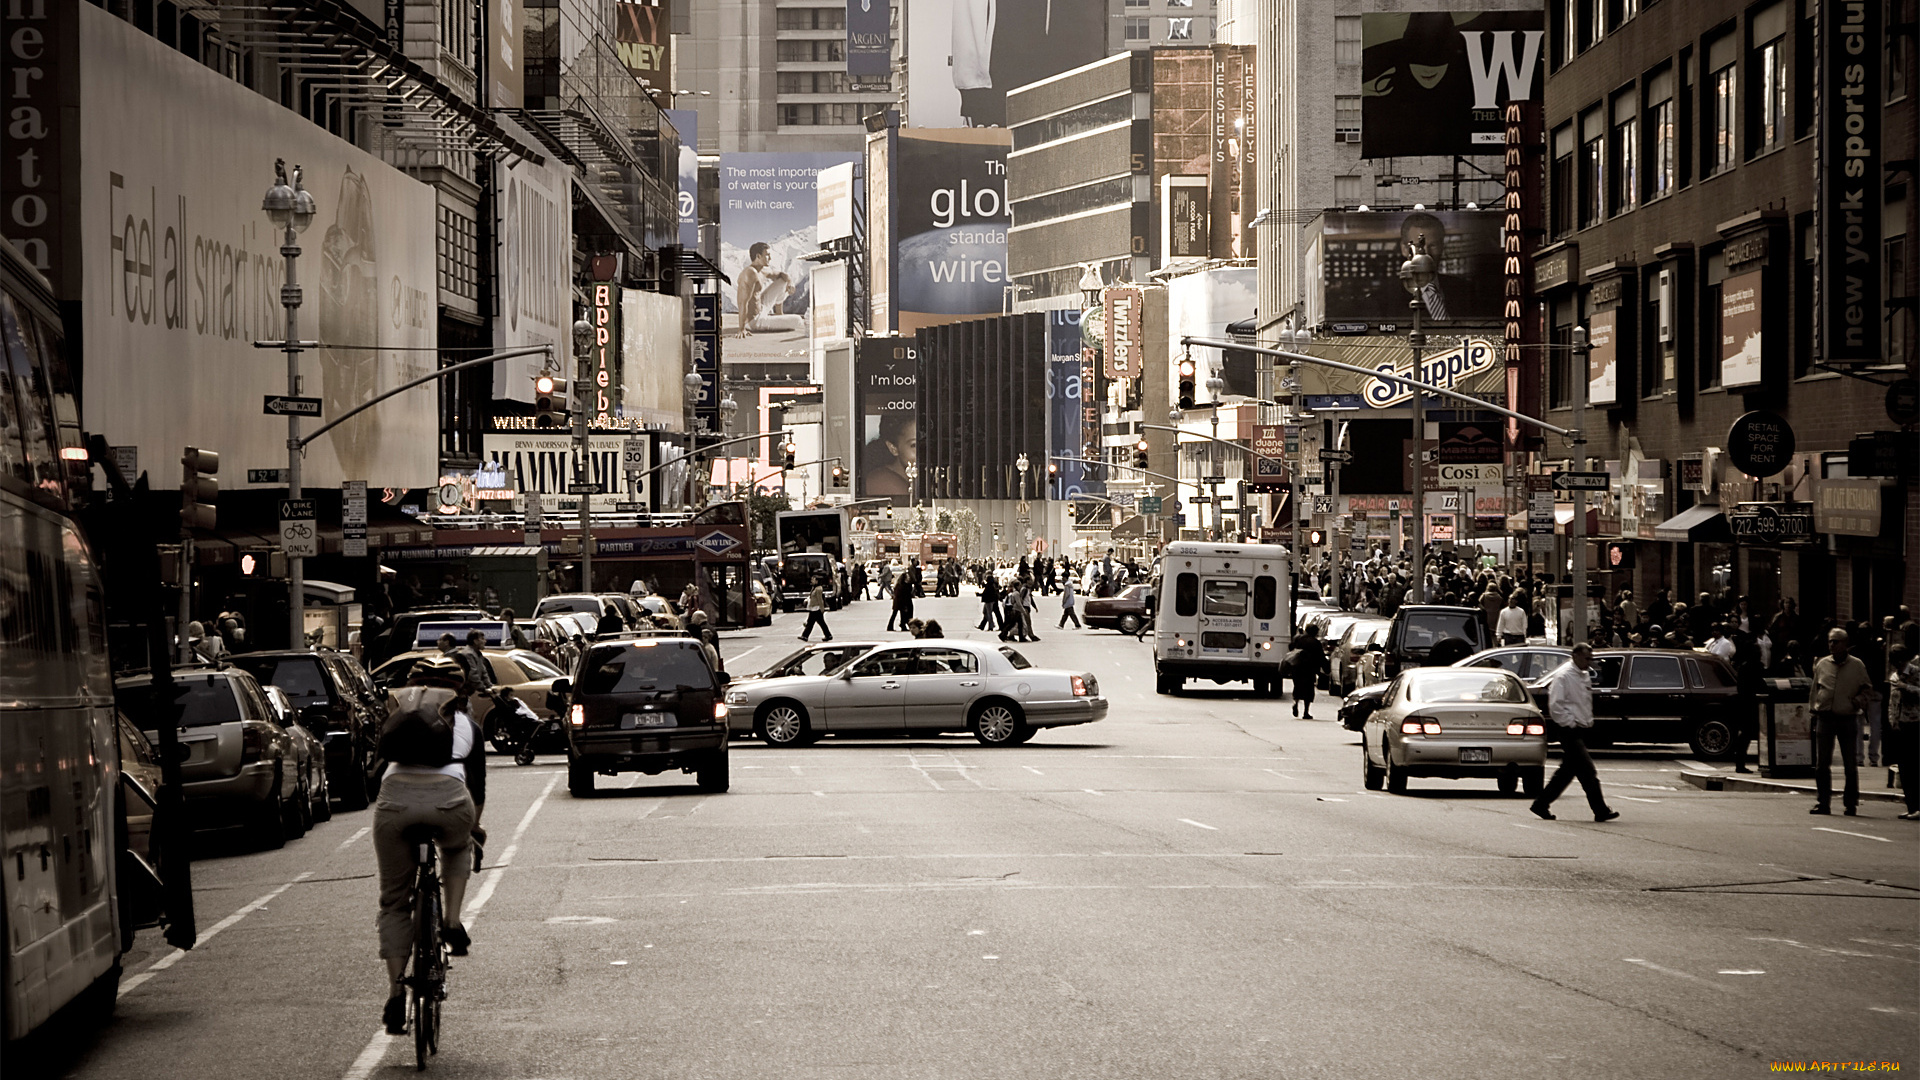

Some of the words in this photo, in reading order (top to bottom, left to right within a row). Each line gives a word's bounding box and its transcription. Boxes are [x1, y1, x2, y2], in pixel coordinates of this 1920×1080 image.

[850, 32, 887, 45] ARGENT
[1216, 61, 1225, 163] HERSHEYS
[1245, 63, 1255, 164] HERSHEYS
[1841, 65, 1871, 178] sports
[727, 167, 747, 177] The
[749, 168, 776, 177] most
[985, 160, 1008, 175] Th
[728, 180, 739, 190] of
[741, 181, 771, 190] water
[773, 180, 782, 190] is
[785, 182, 809, 192] your
[729, 200, 743, 209] Fill
[745, 200, 767, 209] with
[769, 201, 795, 210] care.
[1840, 187, 1869, 264] york
[109, 170, 156, 327] Feel
[164, 194, 188, 331] all
[194, 223, 249, 343] smart
[1846, 279, 1864, 347] new
[1113, 295, 1133, 372] Twizzlers
[1051, 353, 1074, 364] Morgan
[870, 374, 890, 386] I'm
[272, 401, 290, 410] ONE
[296, 402, 315, 411] WAY
[1748, 423, 1780, 433] RETAIL
[1255, 439, 1284, 447] duane
[1748, 434, 1780, 443] SPACE
[515, 441, 534, 449] BENNY
[535, 441, 569, 449] ANDERSSON
[1753, 444, 1774, 452] FOR
[1256, 447, 1283, 455] reade
[625, 452, 642, 462] 30
[1750, 455, 1776, 463] RENT
[258, 471, 268, 481] 52
[1441, 465, 1480, 480] Così
[1560, 477, 1577, 485] ONE
[1584, 477, 1603, 485] WAY
[292, 509, 314, 517] LANE
[600, 542, 634, 552] PARTNER
[652, 540, 678, 550] asics
[388, 550, 400, 560] MY
[402, 549, 436, 560] RUNNING
